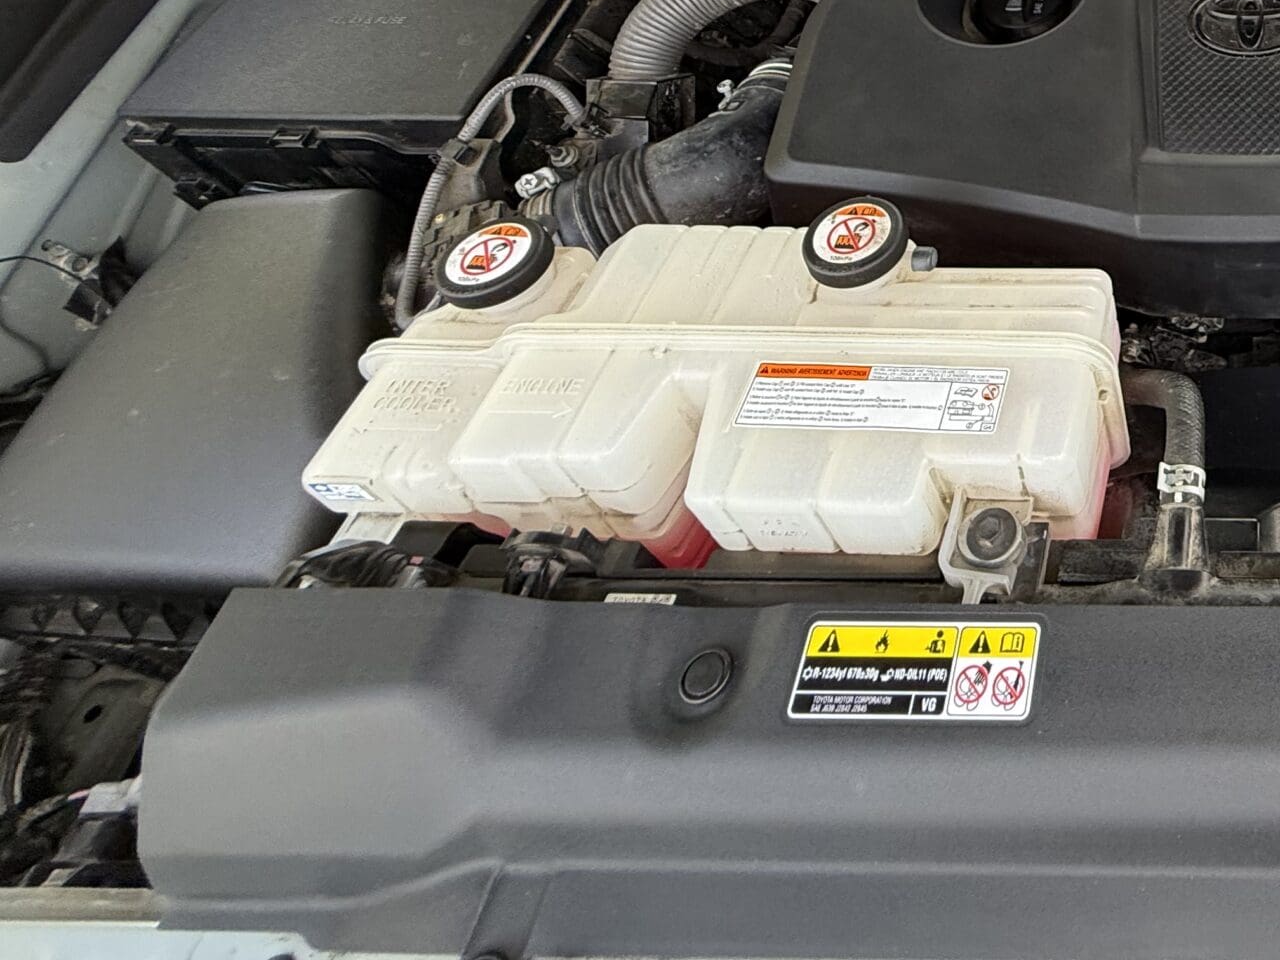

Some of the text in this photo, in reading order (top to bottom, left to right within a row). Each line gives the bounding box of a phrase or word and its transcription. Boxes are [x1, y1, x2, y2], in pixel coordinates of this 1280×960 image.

[386, 378, 451, 395] INTER
[501, 378, 585, 395] ENGINE
[373, 396, 456, 411] COOLER
[812, 667, 848, 682] R-1234yf
[813, 696, 893, 705] TOYOTA MOTOR CORPORATION
[921, 698, 938, 712] VG
